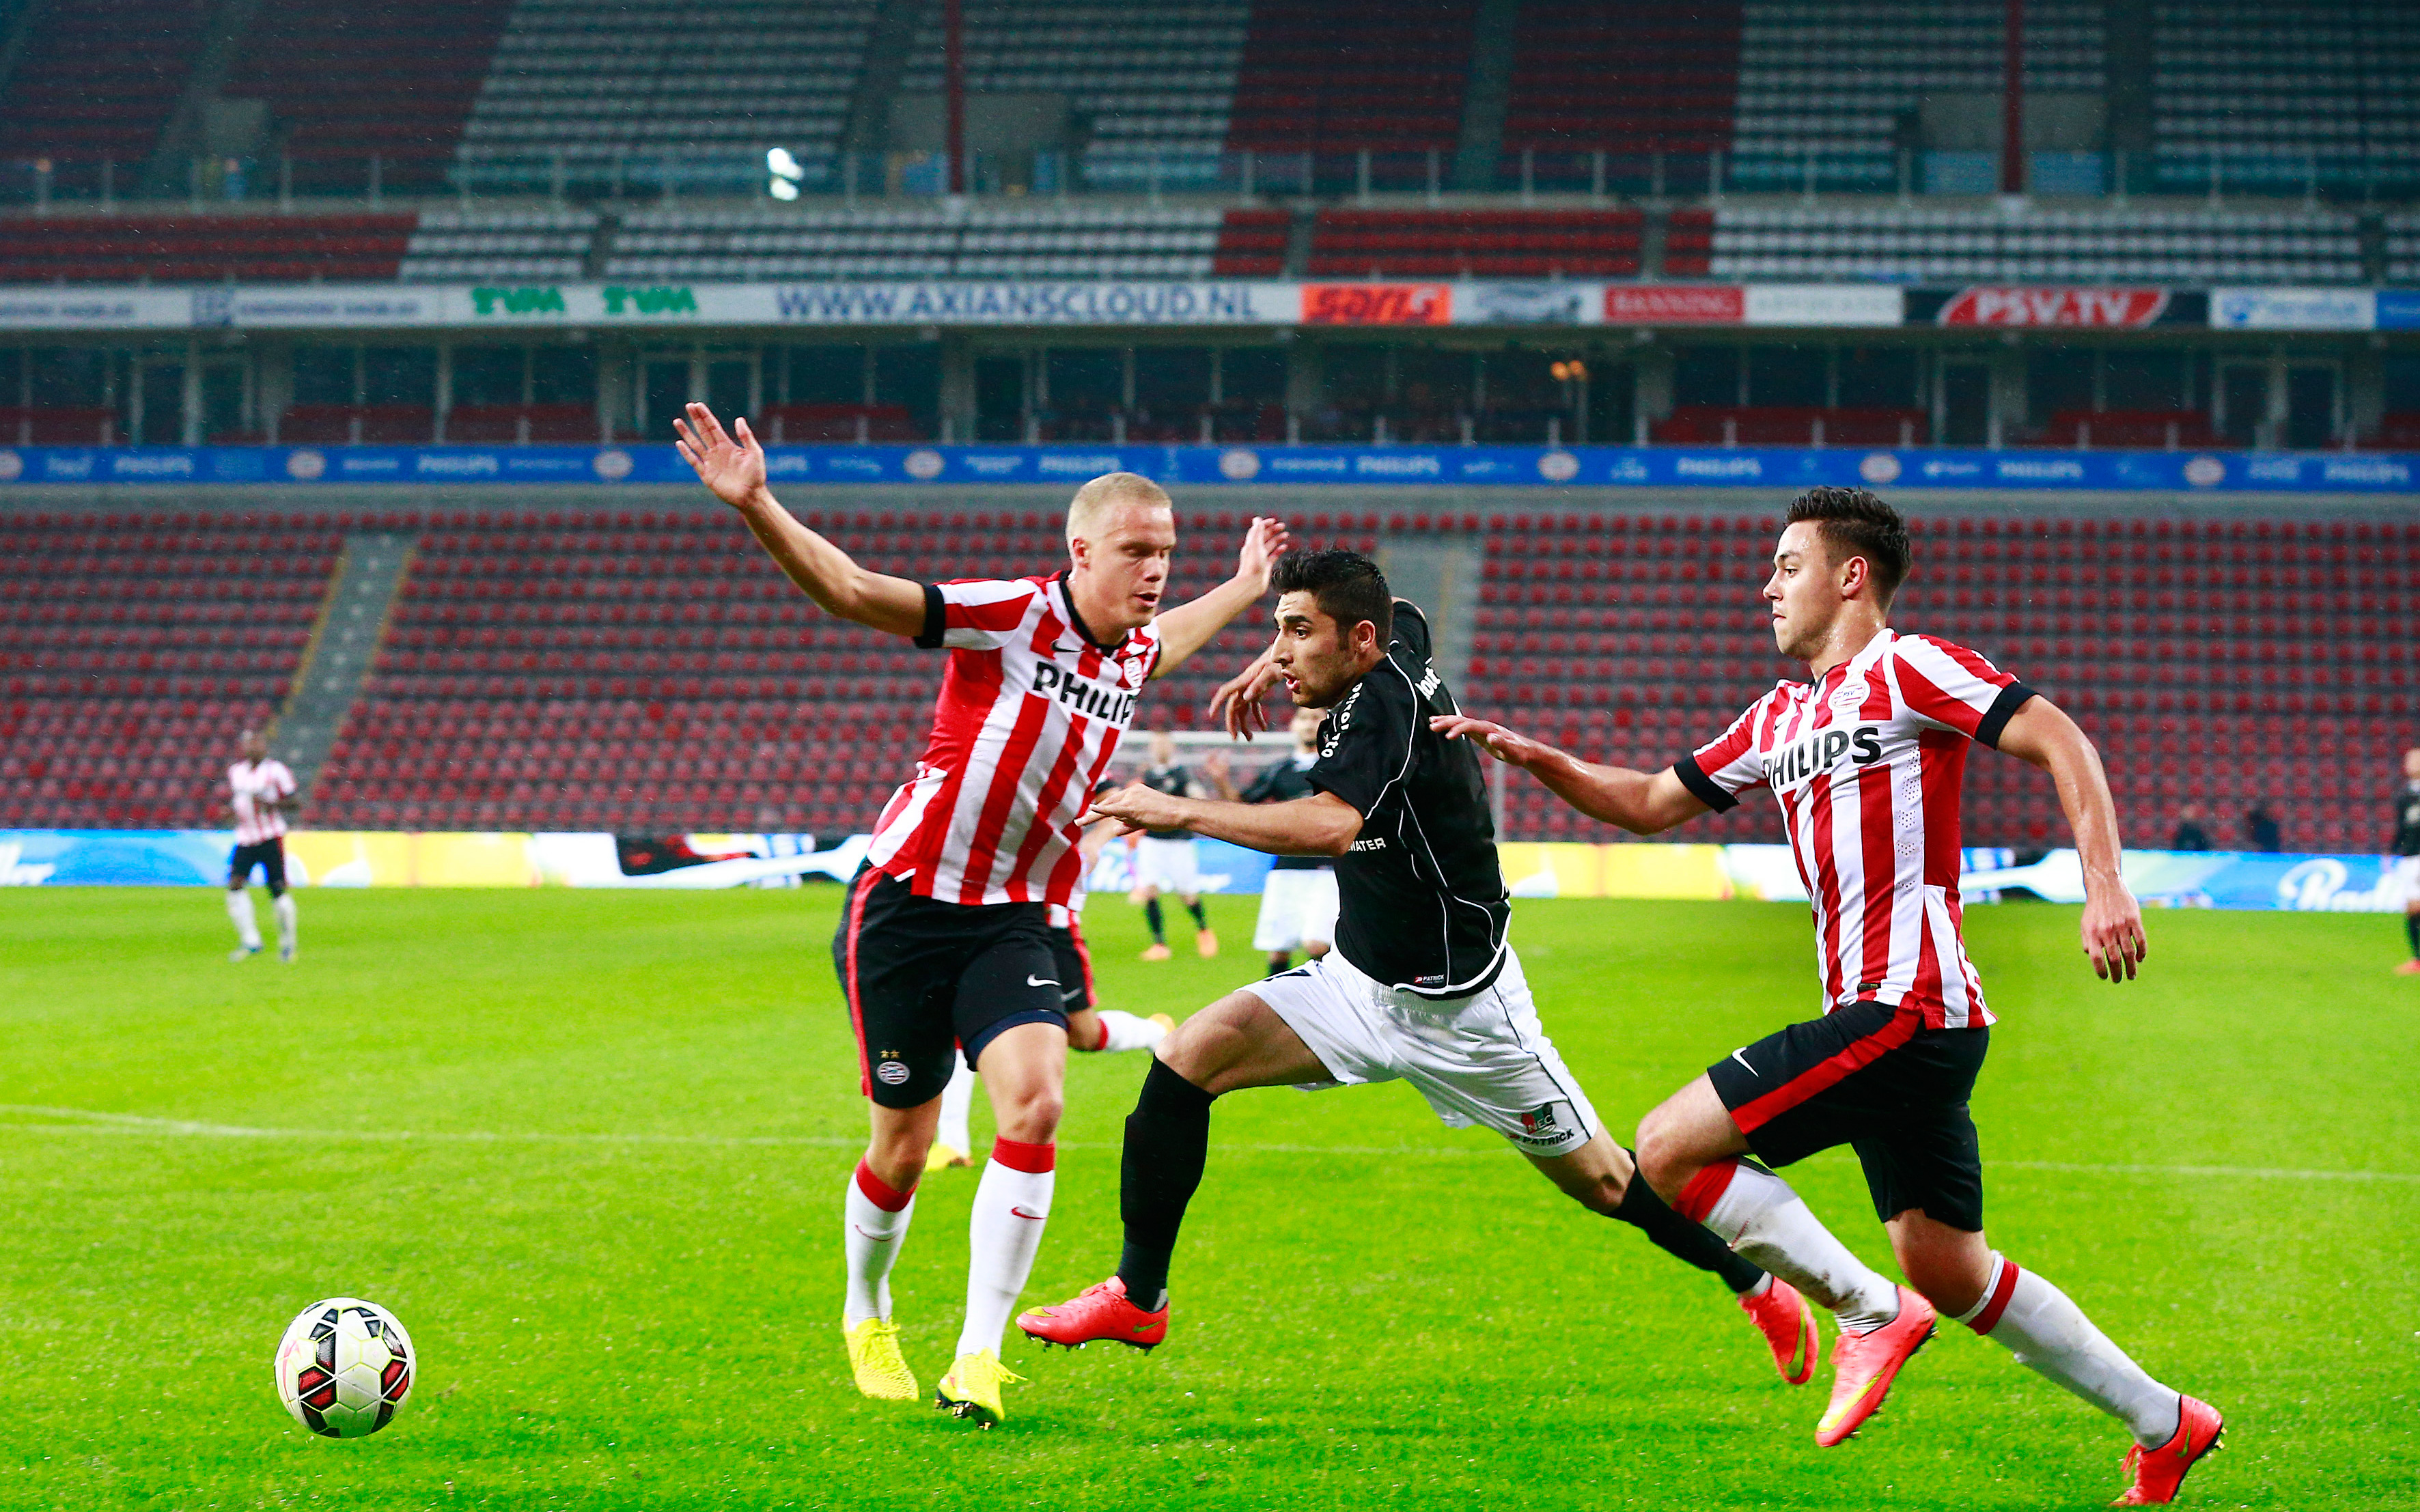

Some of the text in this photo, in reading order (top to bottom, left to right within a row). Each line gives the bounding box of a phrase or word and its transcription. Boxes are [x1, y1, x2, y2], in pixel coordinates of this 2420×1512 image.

[776, 285, 1257, 319] WWW.AXIANSCLOUD.NL
[1976, 290, 2133, 325] PSV.TV
[1763, 727, 1882, 789] PHILIPS
[1522, 1129, 1575, 1145] PATRICK
[1528, 1115, 1553, 1132] NEC
